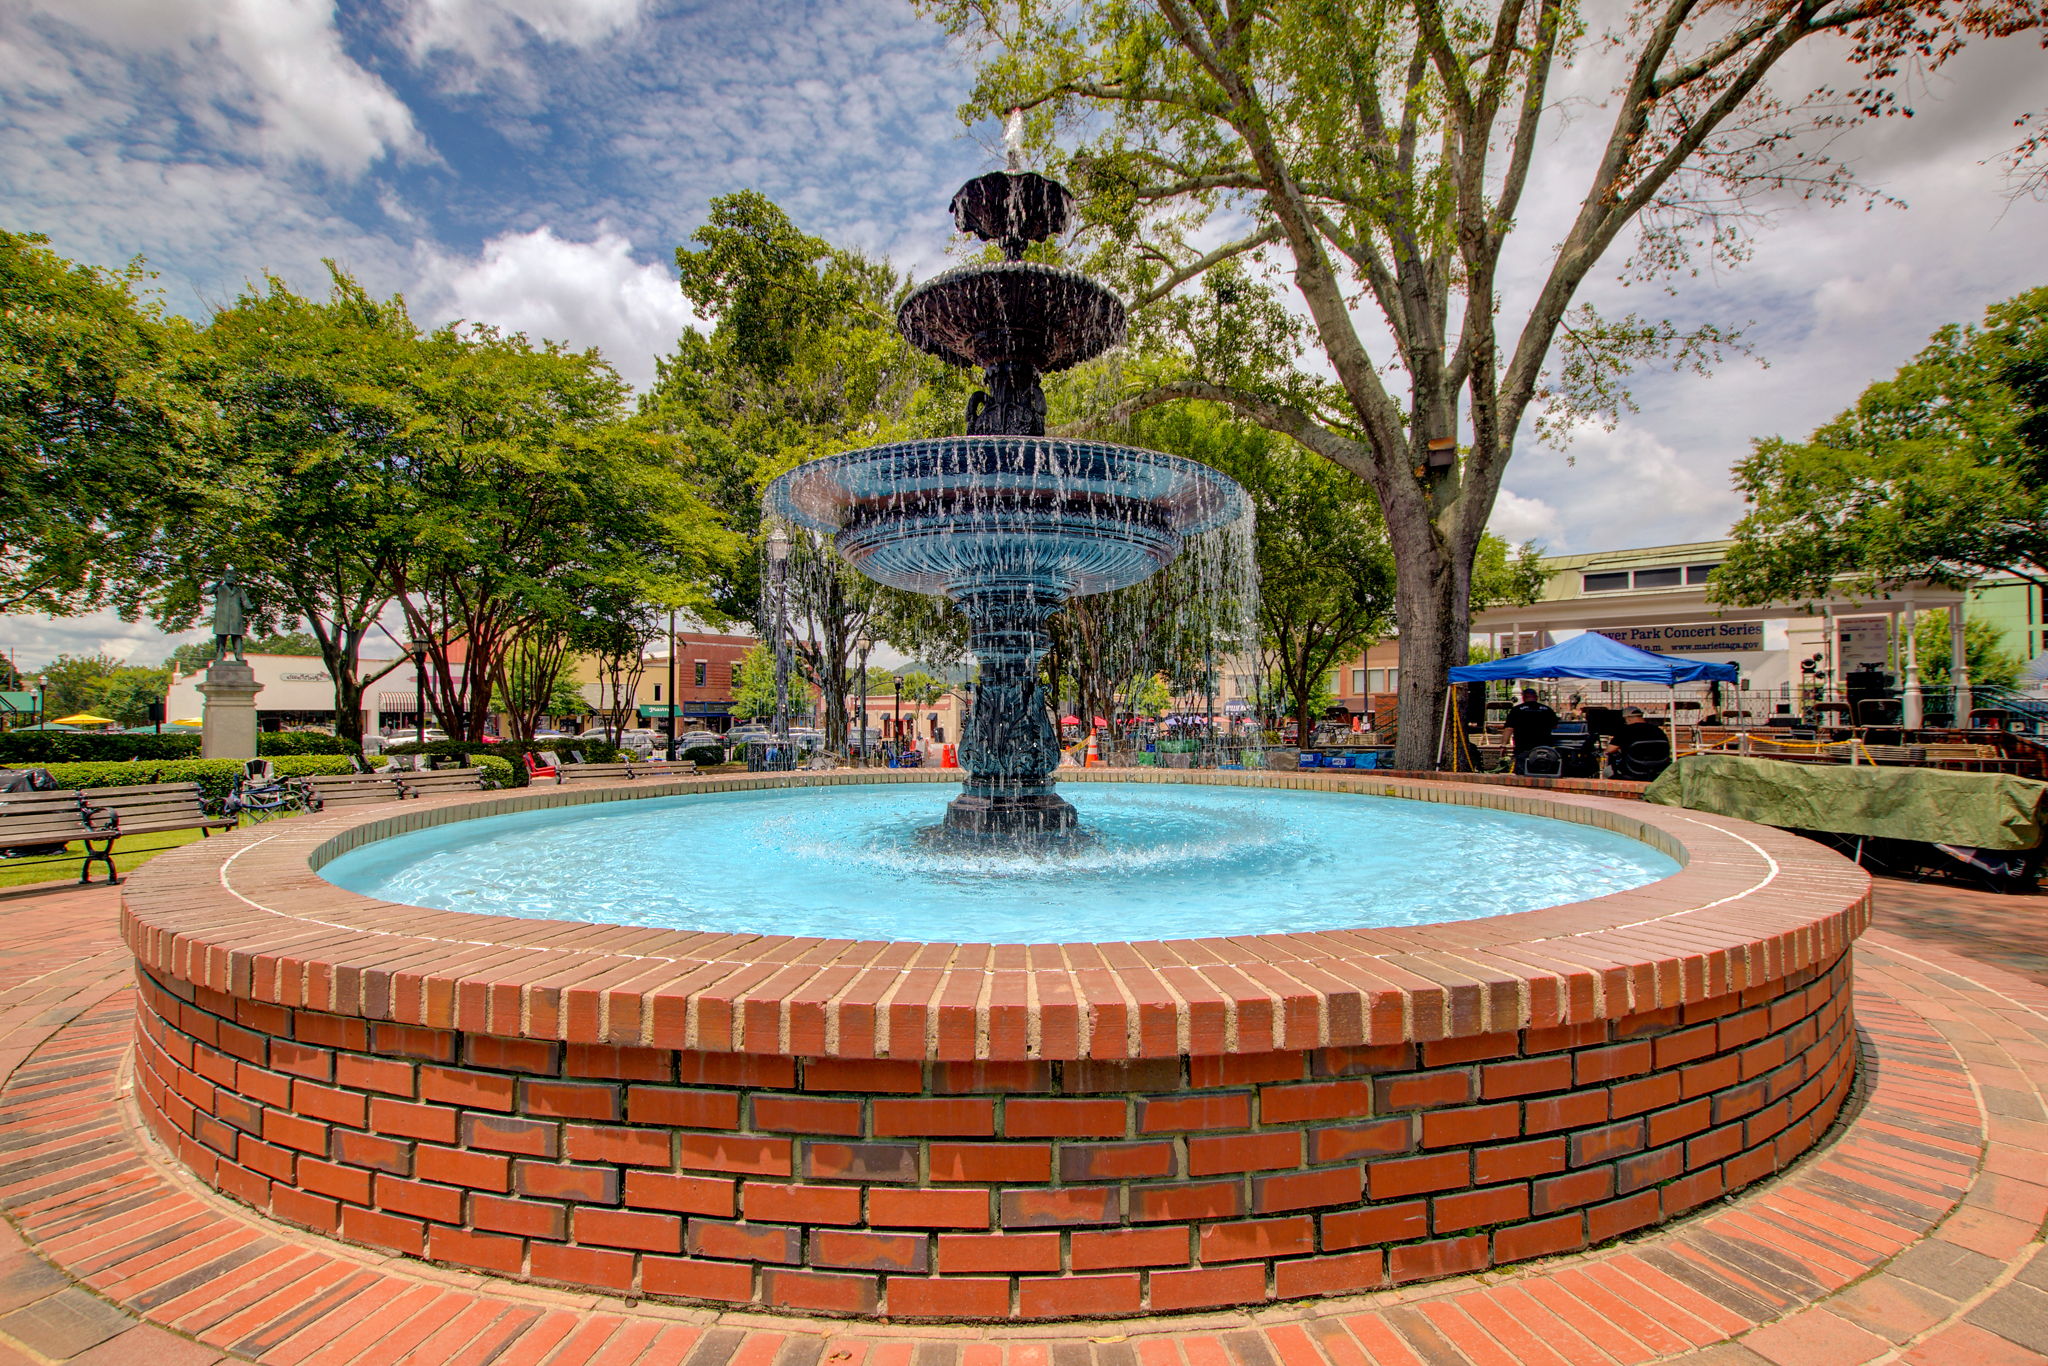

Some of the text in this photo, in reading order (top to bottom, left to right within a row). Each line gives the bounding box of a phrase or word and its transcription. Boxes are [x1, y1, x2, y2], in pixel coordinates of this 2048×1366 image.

[1631, 627, 1661, 640] Park
[1665, 626, 1716, 639] Concert
[1720, 623, 1762, 636] Series
